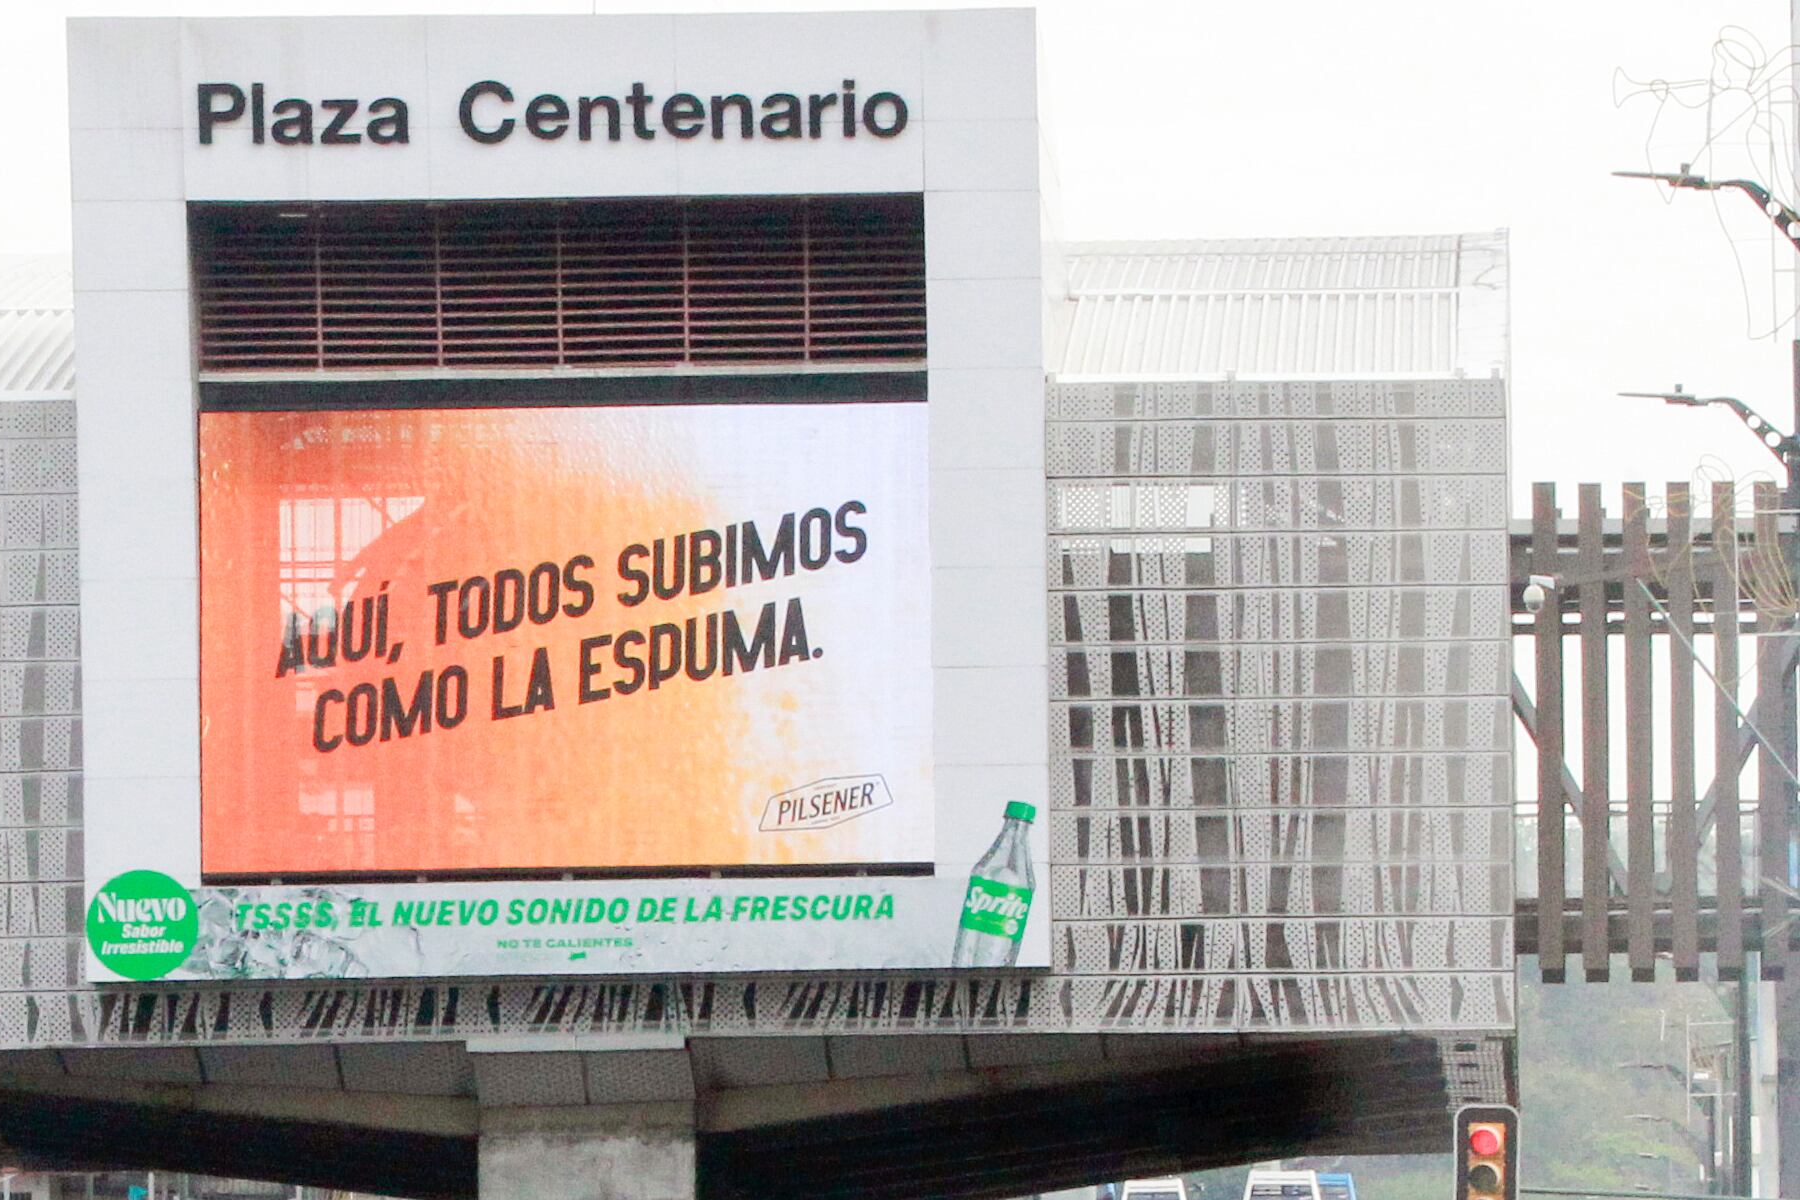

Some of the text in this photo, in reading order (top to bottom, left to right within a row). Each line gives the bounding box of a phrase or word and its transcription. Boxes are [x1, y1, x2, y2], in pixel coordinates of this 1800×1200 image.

[196, 79, 909, 146] Plaza Centenario
[275, 499, 868, 680] AQUÍ, TODOS SUBIMOS
[313, 596, 824, 753] COMO LA ESPUMA.
[777, 782, 876, 826] PILSENER
[97, 891, 187, 924] Nuevo
[235, 893, 895, 931] TSSSS, EL NUEVO SONIDO DE LA FRESCURA
[966, 886, 1028, 919] Sprite
[101, 939, 185, 956] Irresistible
[121, 922, 168, 939] Sabor
[496, 935, 634, 950] NO TE CALIENTES
